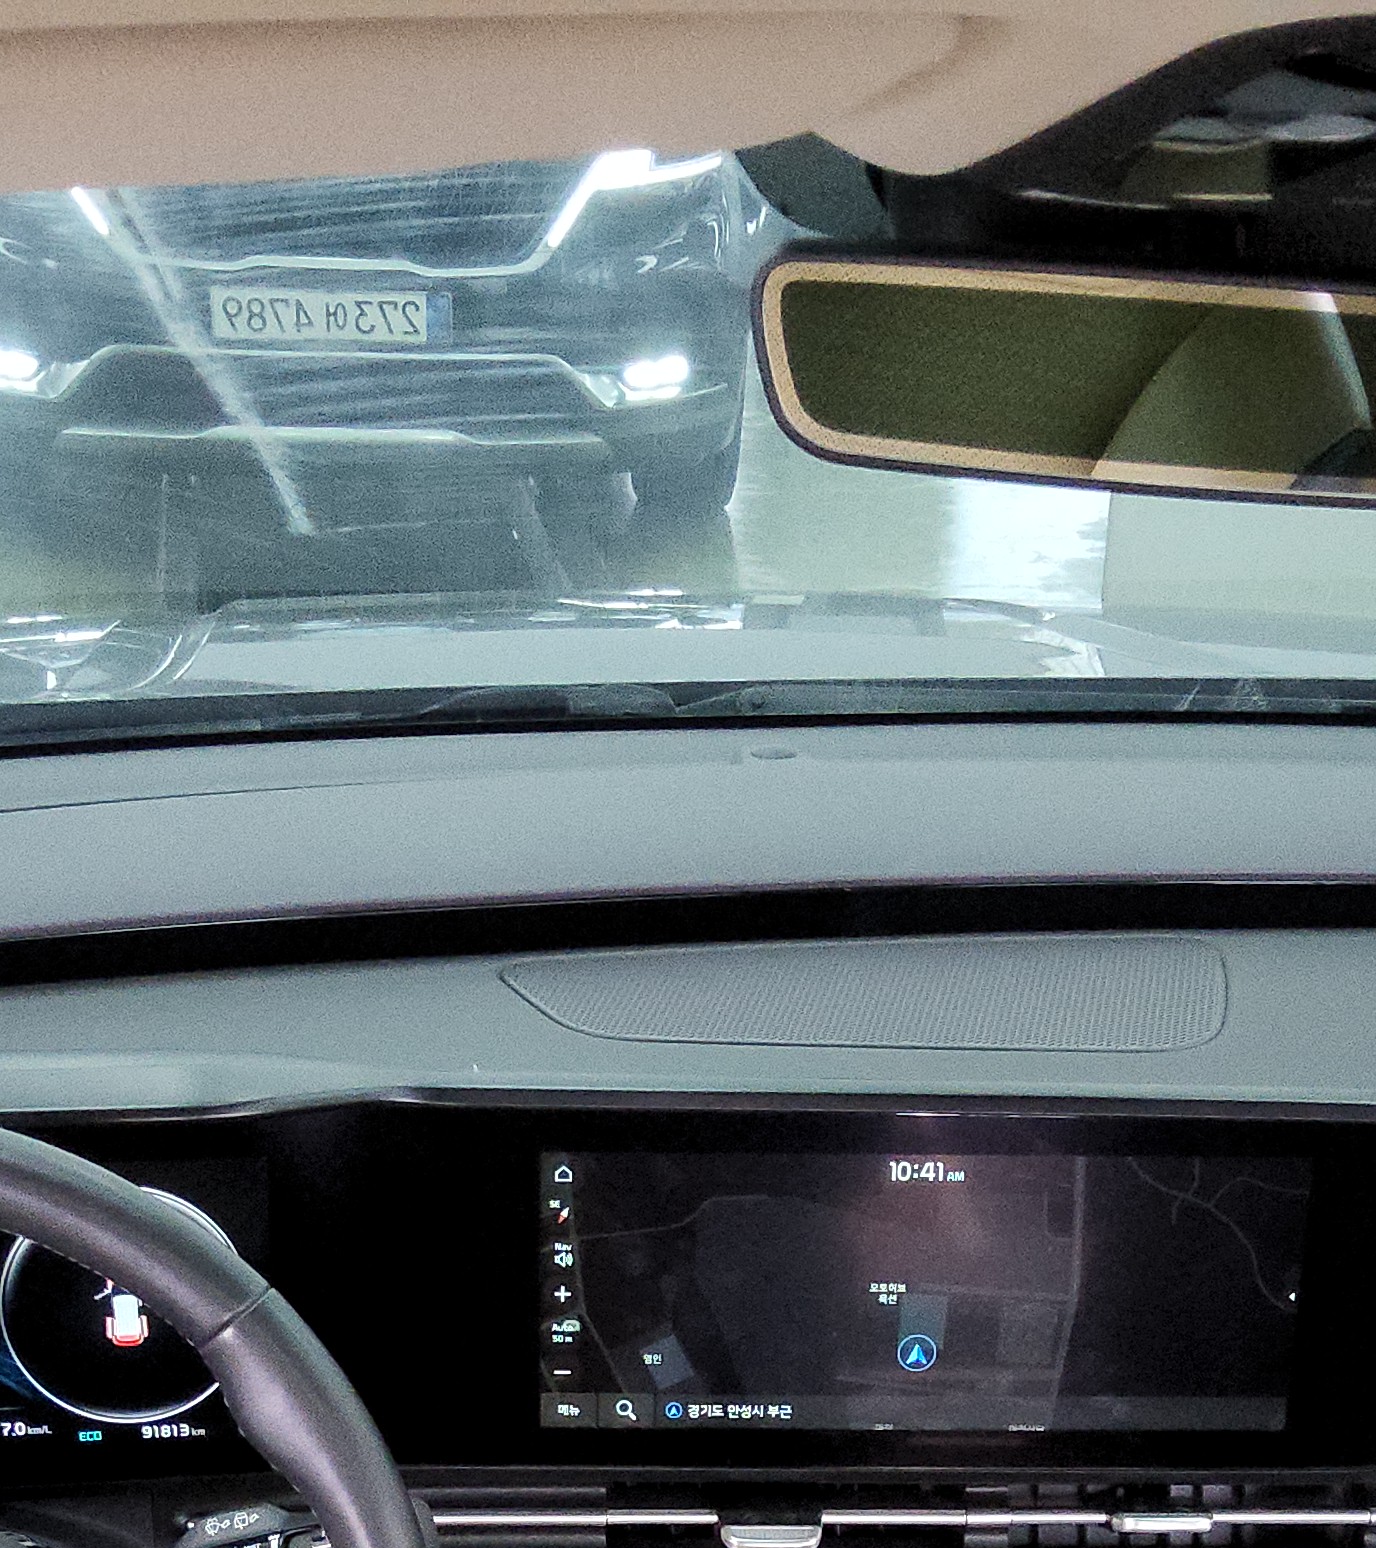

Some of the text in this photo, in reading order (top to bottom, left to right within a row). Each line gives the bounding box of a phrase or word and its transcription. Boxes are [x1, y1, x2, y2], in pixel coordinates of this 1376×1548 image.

[889, 1160, 965, 1182] 10:41 AM
[688, 1404, 792, 1419] 경기도 안성시 부근
[78, 1430, 103, 1442] ECO
